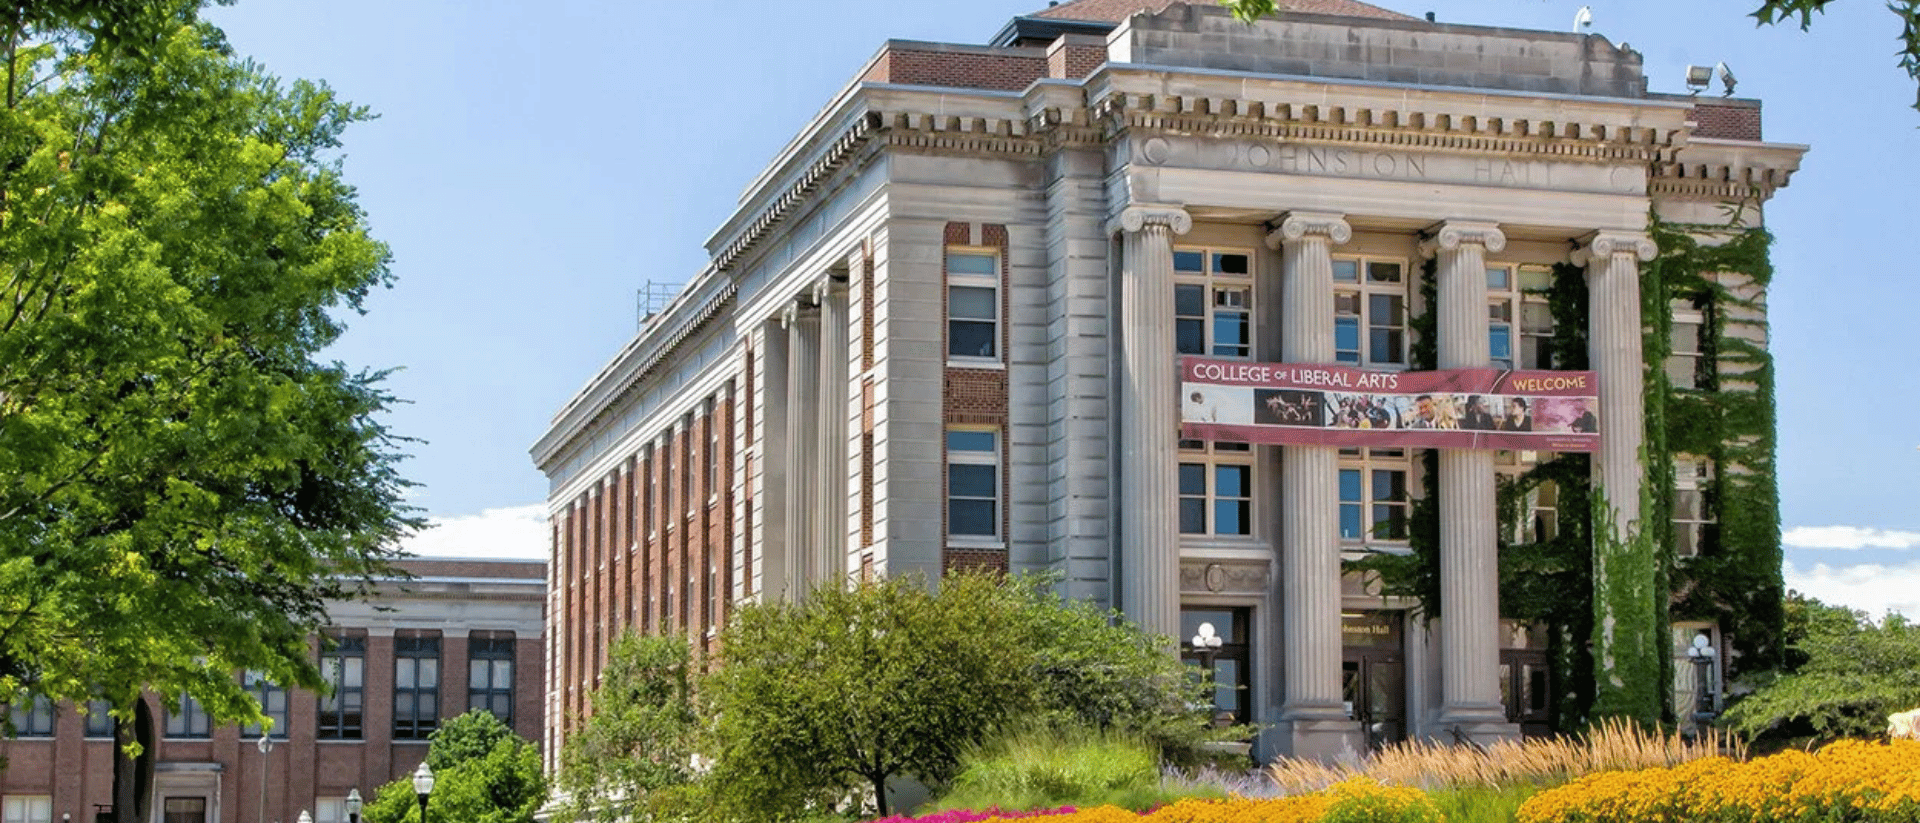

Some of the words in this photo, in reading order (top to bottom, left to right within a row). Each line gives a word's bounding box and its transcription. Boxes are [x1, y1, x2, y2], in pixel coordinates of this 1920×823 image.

[1226, 141, 1426, 177] JOHNSTON
[1474, 158, 1560, 187] HALL
[1193, 363, 1271, 382] COLLEGE
[1291, 368, 1352, 388] LIBERAL
[1356, 373, 1399, 389] ARTS
[1513, 376, 1587, 391] WELCOME
[1372, 625, 1389, 634] Hall
